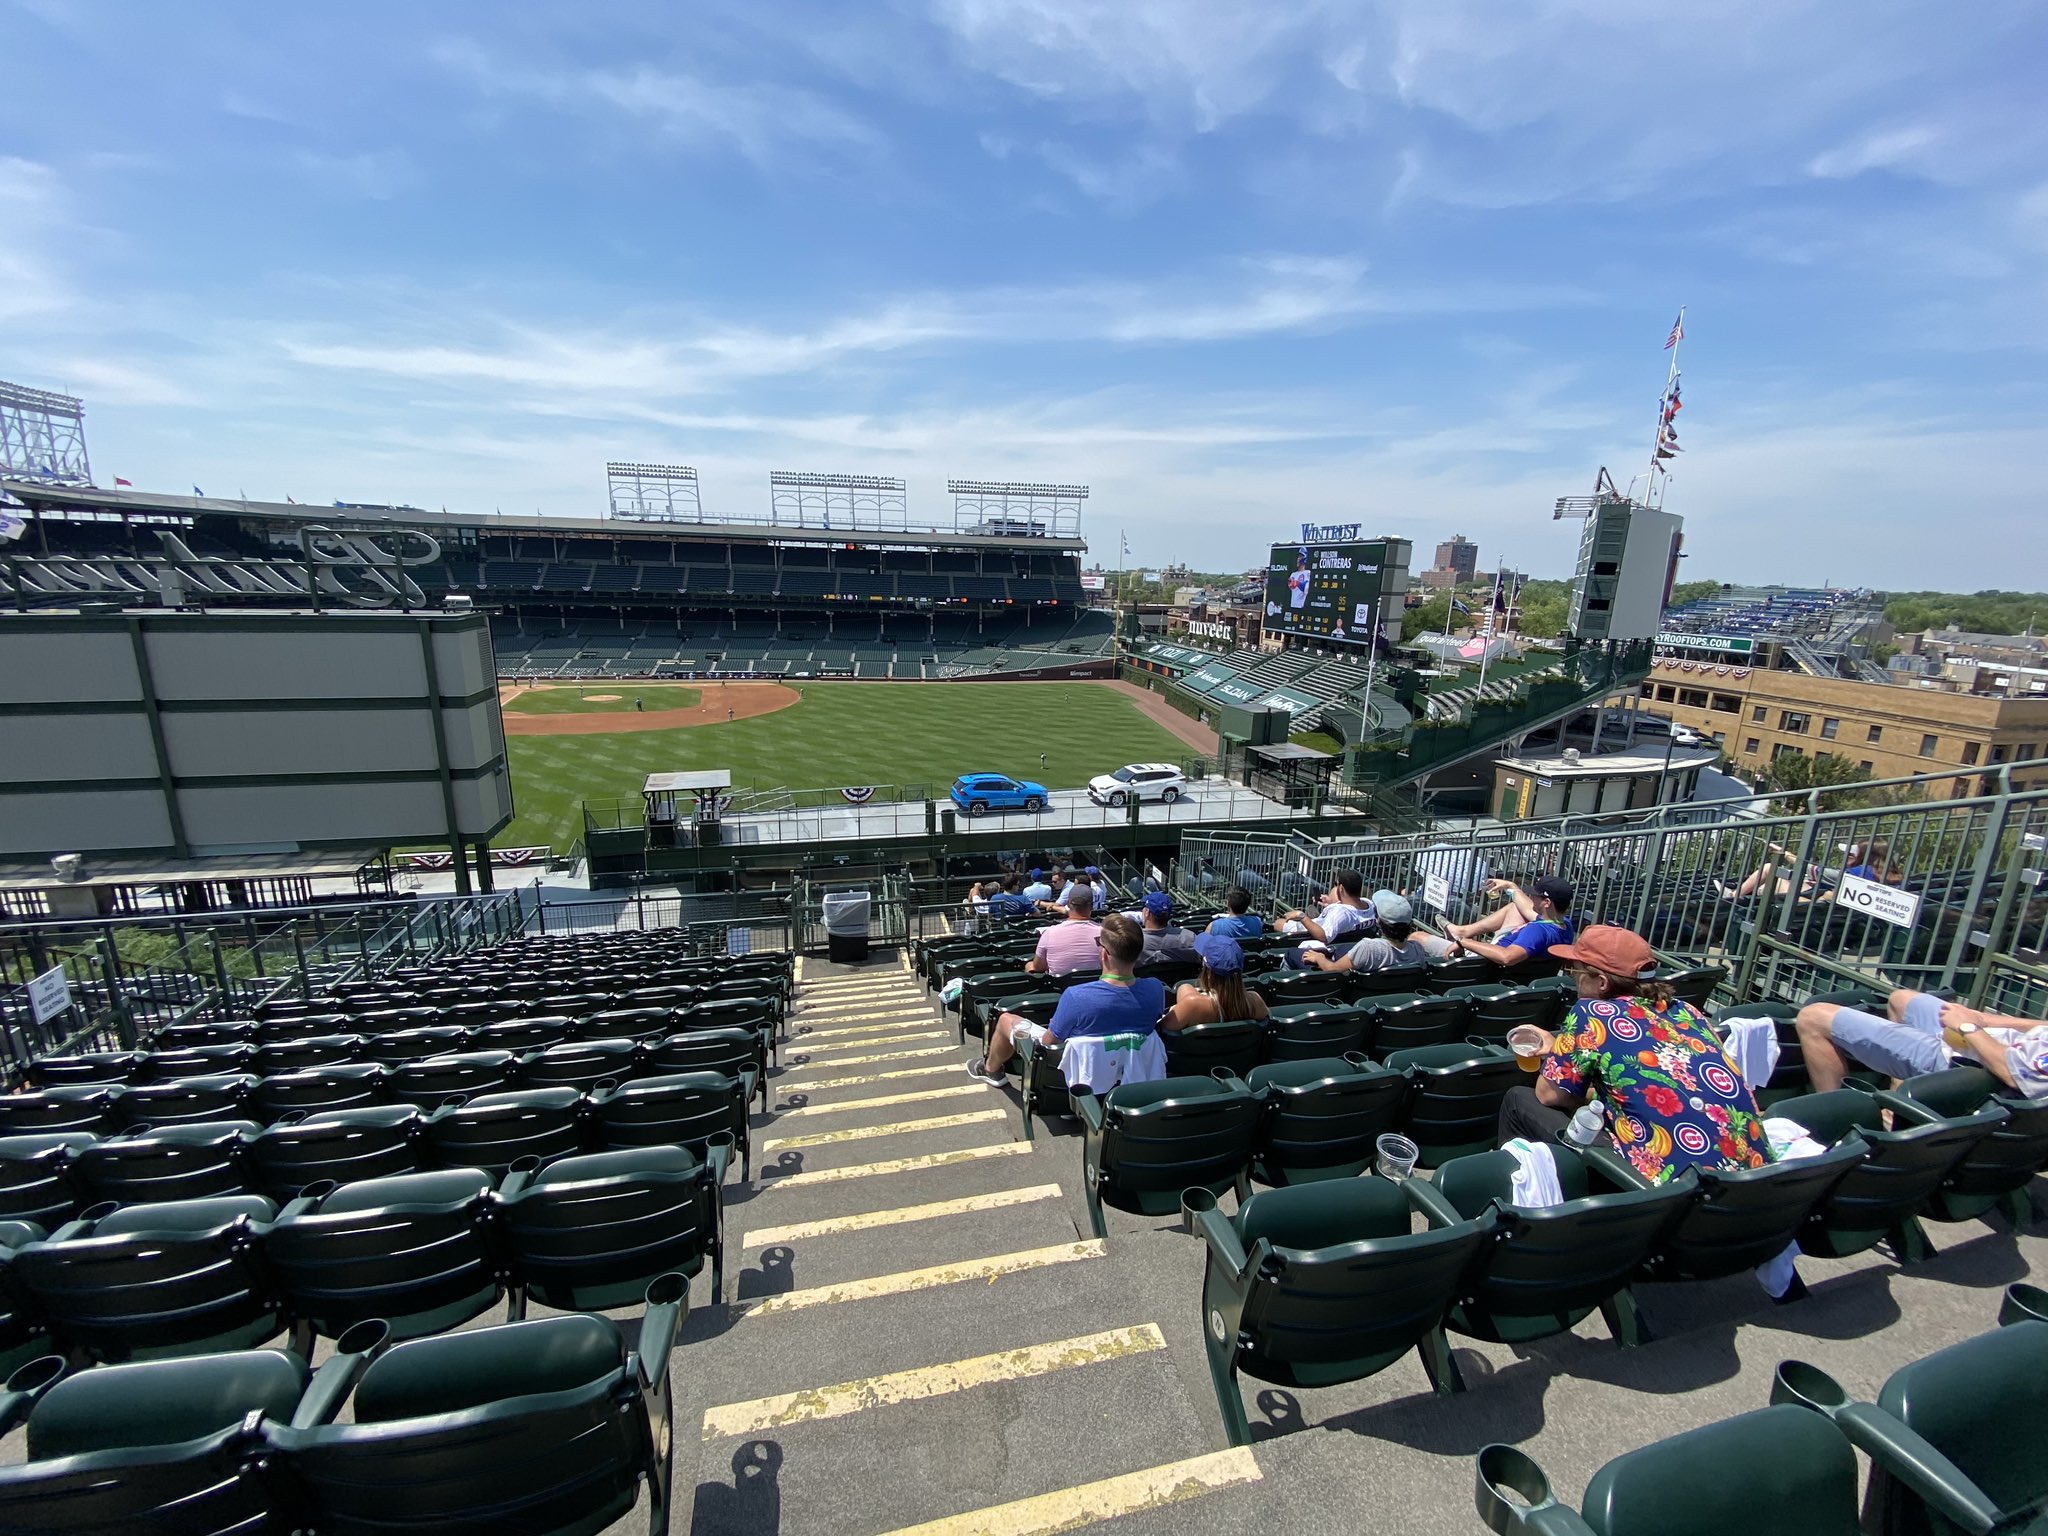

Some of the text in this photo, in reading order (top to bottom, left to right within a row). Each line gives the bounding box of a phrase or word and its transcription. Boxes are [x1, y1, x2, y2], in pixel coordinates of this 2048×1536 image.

[1302, 523, 1361, 542] WINTRUST
[1320, 558, 1352, 569] CONTRERAS
[1351, 626, 1368, 634] TOYOTA
[1418, 635, 1469, 647] guaranteed
[1220, 684, 1253, 700] SLOAN
[1843, 887, 1910, 912] NO RESERVED
[1875, 904, 1906, 919] SEATING
[44, 983, 55, 993] NO
[38, 987, 65, 1006] RESERVED
